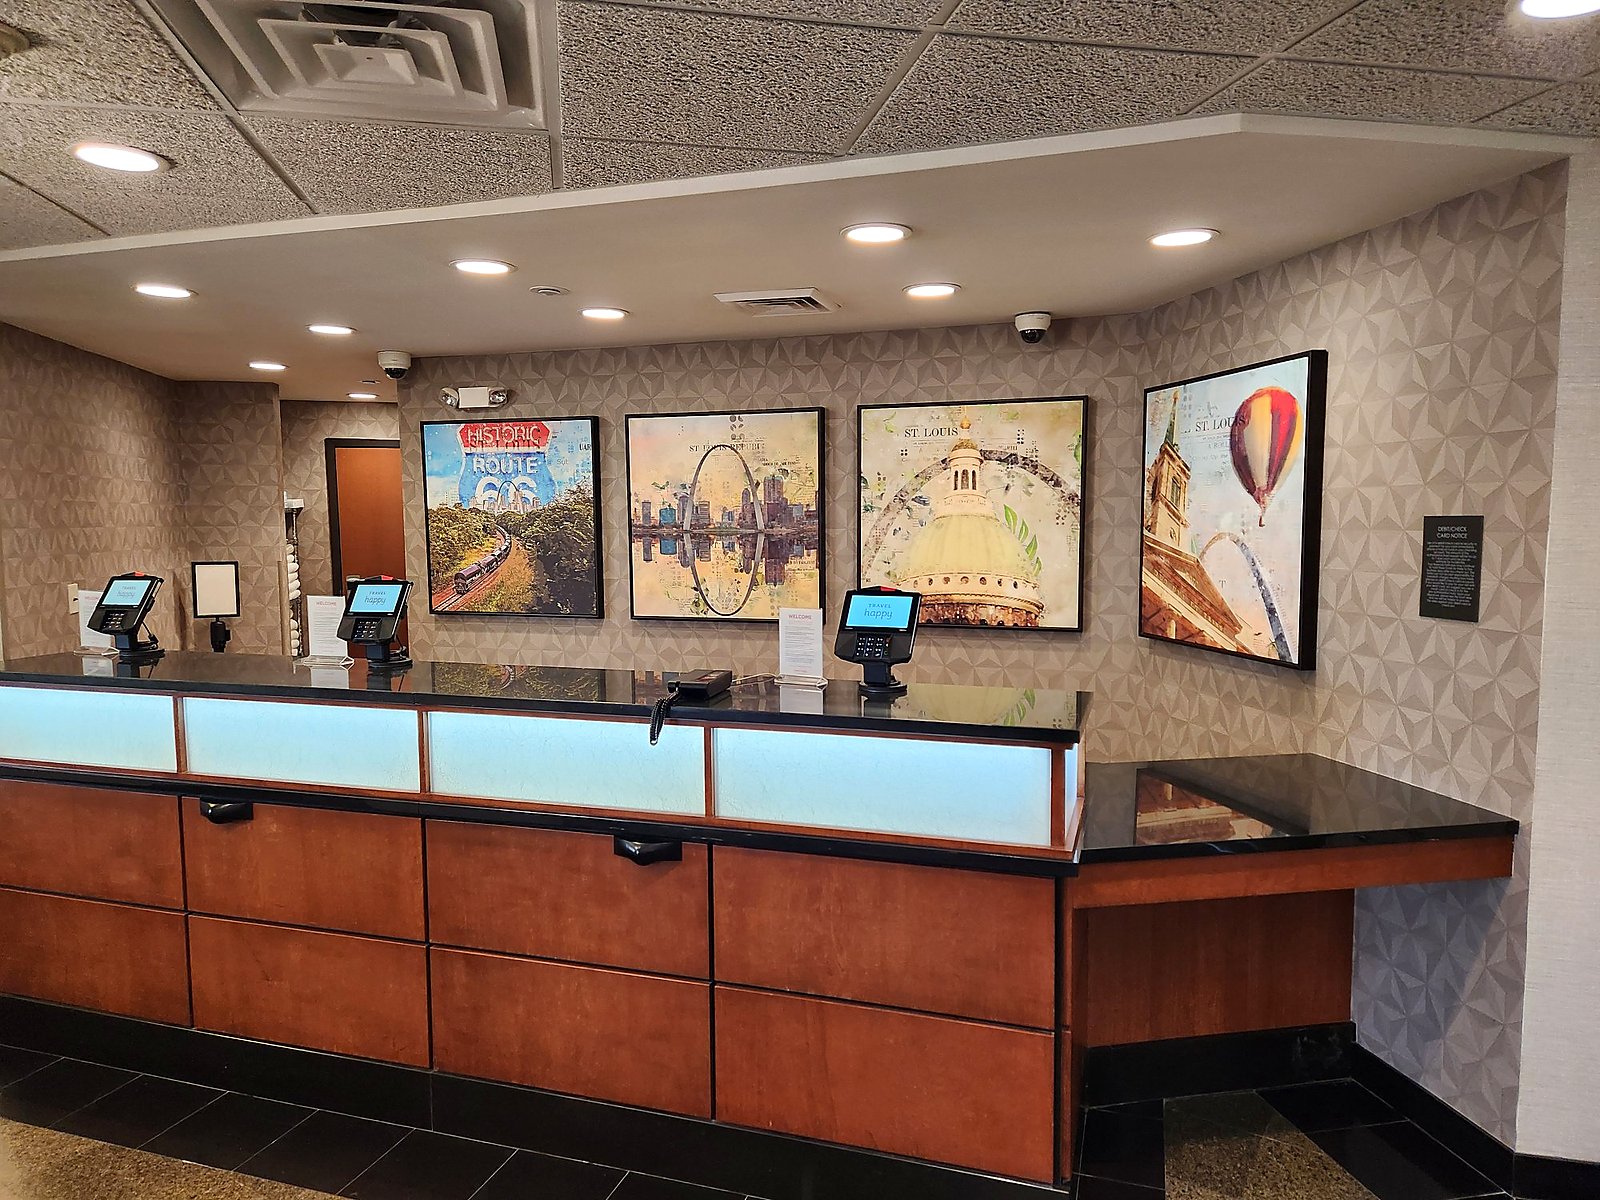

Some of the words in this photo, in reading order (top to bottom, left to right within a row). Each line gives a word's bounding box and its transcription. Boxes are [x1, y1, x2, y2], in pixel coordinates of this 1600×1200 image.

[1195, 420, 1210, 432] ST.
[468, 426, 540, 444] HISTORIC
[904, 429, 920, 438] ST.
[924, 427, 959, 437] LOUIS
[473, 456, 538, 474] ROUTE
[864, 608, 893, 620] happy
